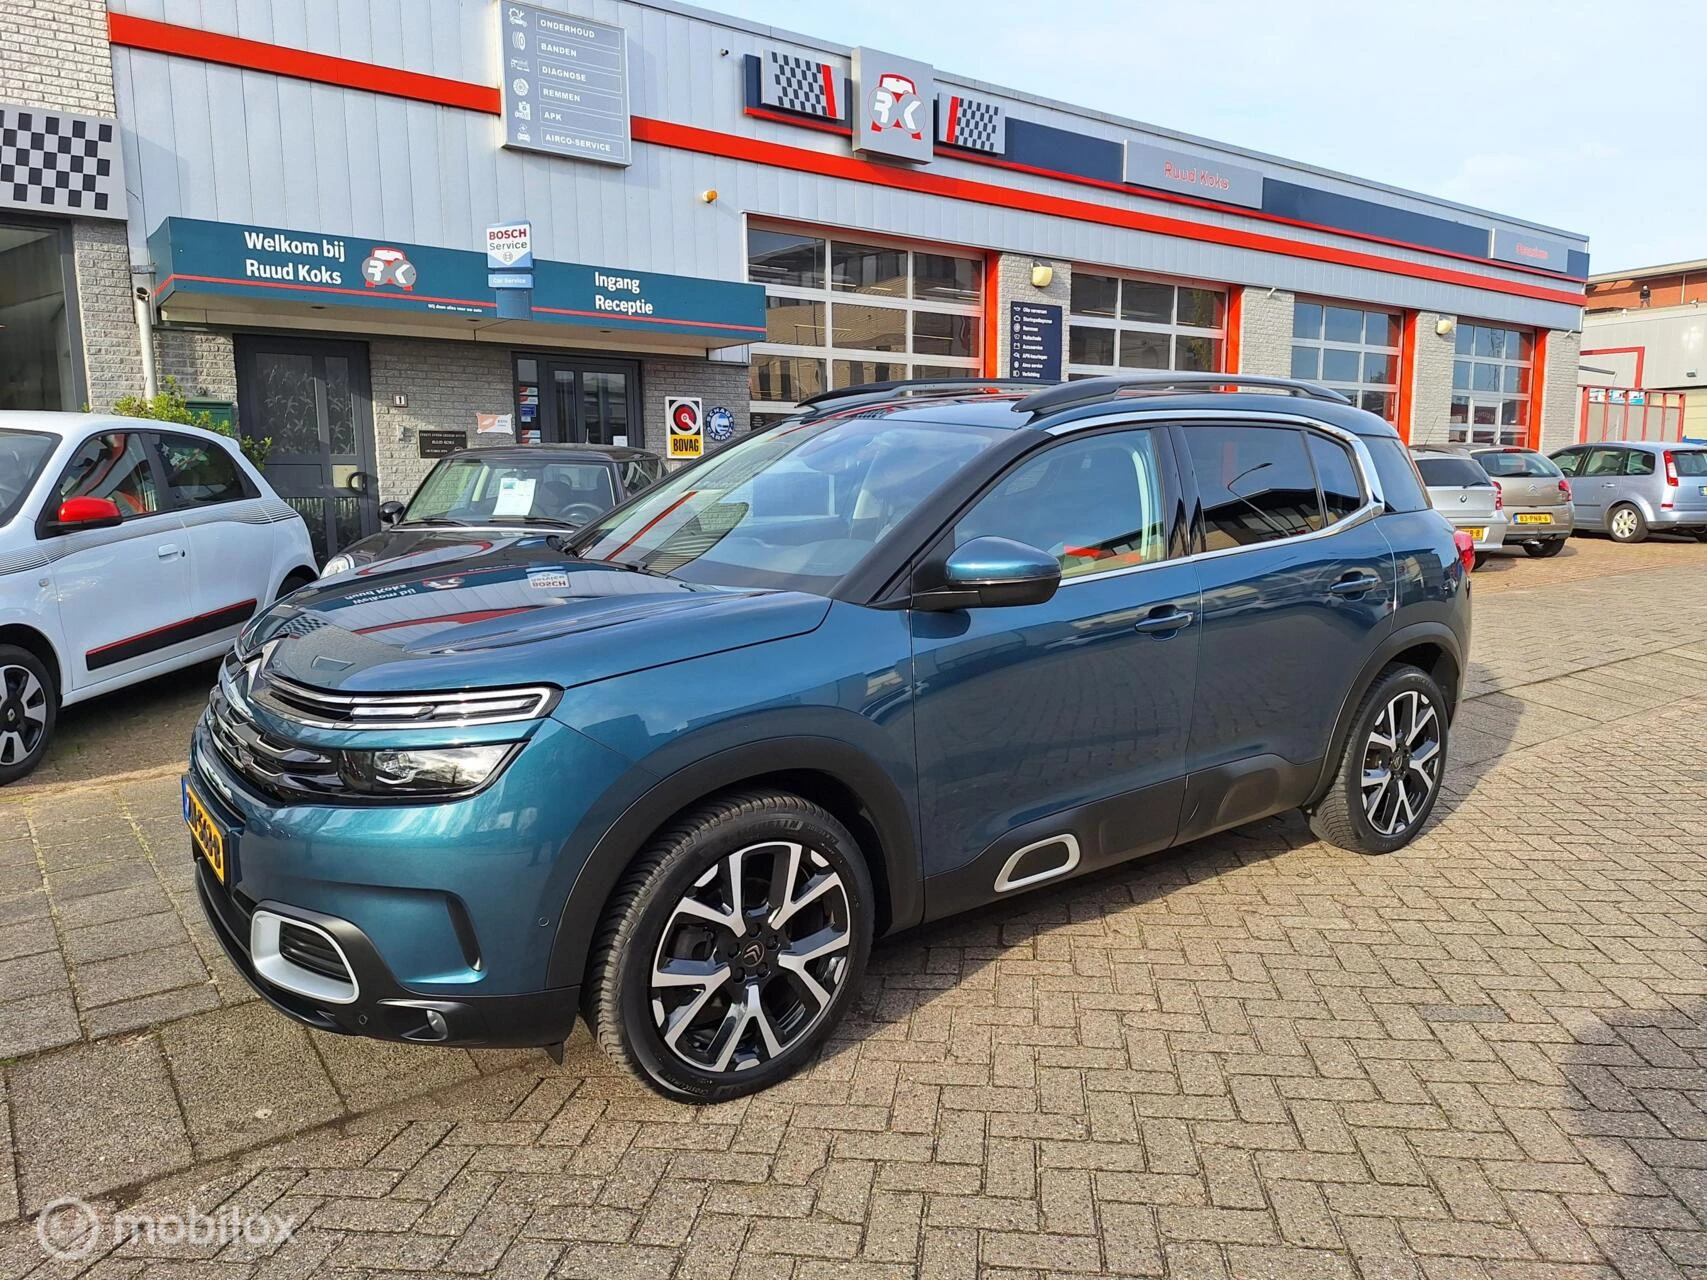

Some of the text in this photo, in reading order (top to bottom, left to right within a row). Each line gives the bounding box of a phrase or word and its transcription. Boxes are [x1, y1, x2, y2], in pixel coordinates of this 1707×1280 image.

[540, 19, 595, 39] ONDERHOUD
[541, 42, 577, 57] BANDEN
[542, 66, 586, 82] DIAGNOSE
[543, 88, 581, 102] REMMEN
[544, 111, 562, 121] APK
[545, 133, 611, 152] AIRCO-SERVICE
[1164, 160, 1230, 191] Ruud Koks
[489, 228, 527, 240] BOSCH
[244, 231, 345, 262] Welkom bij
[489, 241, 527, 250] Service
[245, 259, 342, 285] Ruud Koks
[595, 272, 640, 293] Ingang
[595, 294, 653, 315] Receptie
[706, 407, 734, 423] SCHADE
[706, 427, 733, 441] GARANT
[673, 438, 699, 453] BOVAG
